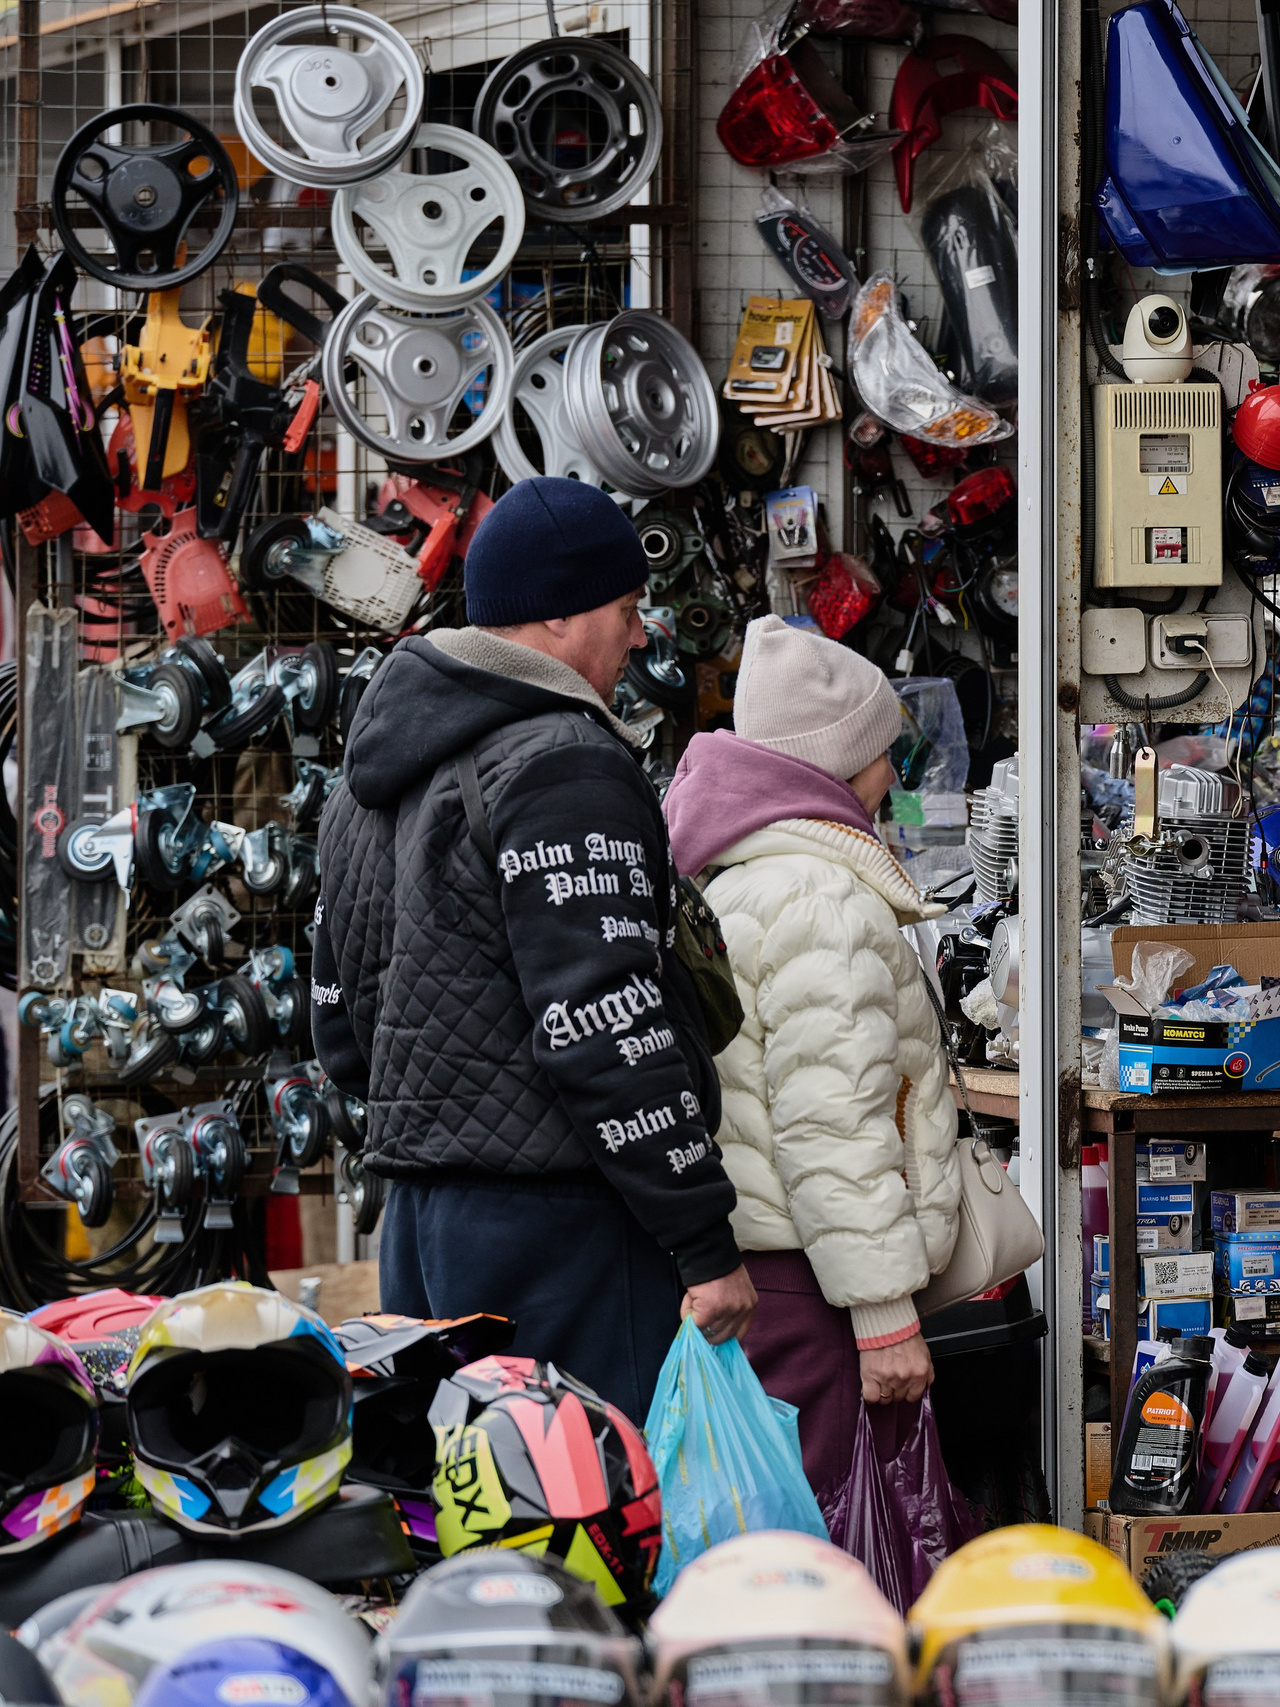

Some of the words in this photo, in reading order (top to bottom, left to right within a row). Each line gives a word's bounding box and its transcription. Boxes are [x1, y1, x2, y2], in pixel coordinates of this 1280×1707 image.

[499, 840, 574, 884] Palm
[585, 832, 646, 867] Ange
[544, 866, 620, 906] Palm
[600, 915, 642, 943] Palm
[543, 972, 663, 1051] Angels
[616, 1026, 675, 1066] Palm
[1135, 1024, 1149, 1034] Pump
[1163, 1029, 1206, 1039] KOMATCU
[597, 1106, 676, 1153] Palm
[666, 1140, 706, 1174] Palm
[1146, 1407, 1176, 1416] PATRIOT
[587, 1522, 624, 1575] EDX-11
[1144, 1522, 1222, 1553] TMMP
[1143, 1555, 1166, 1565] GEN
